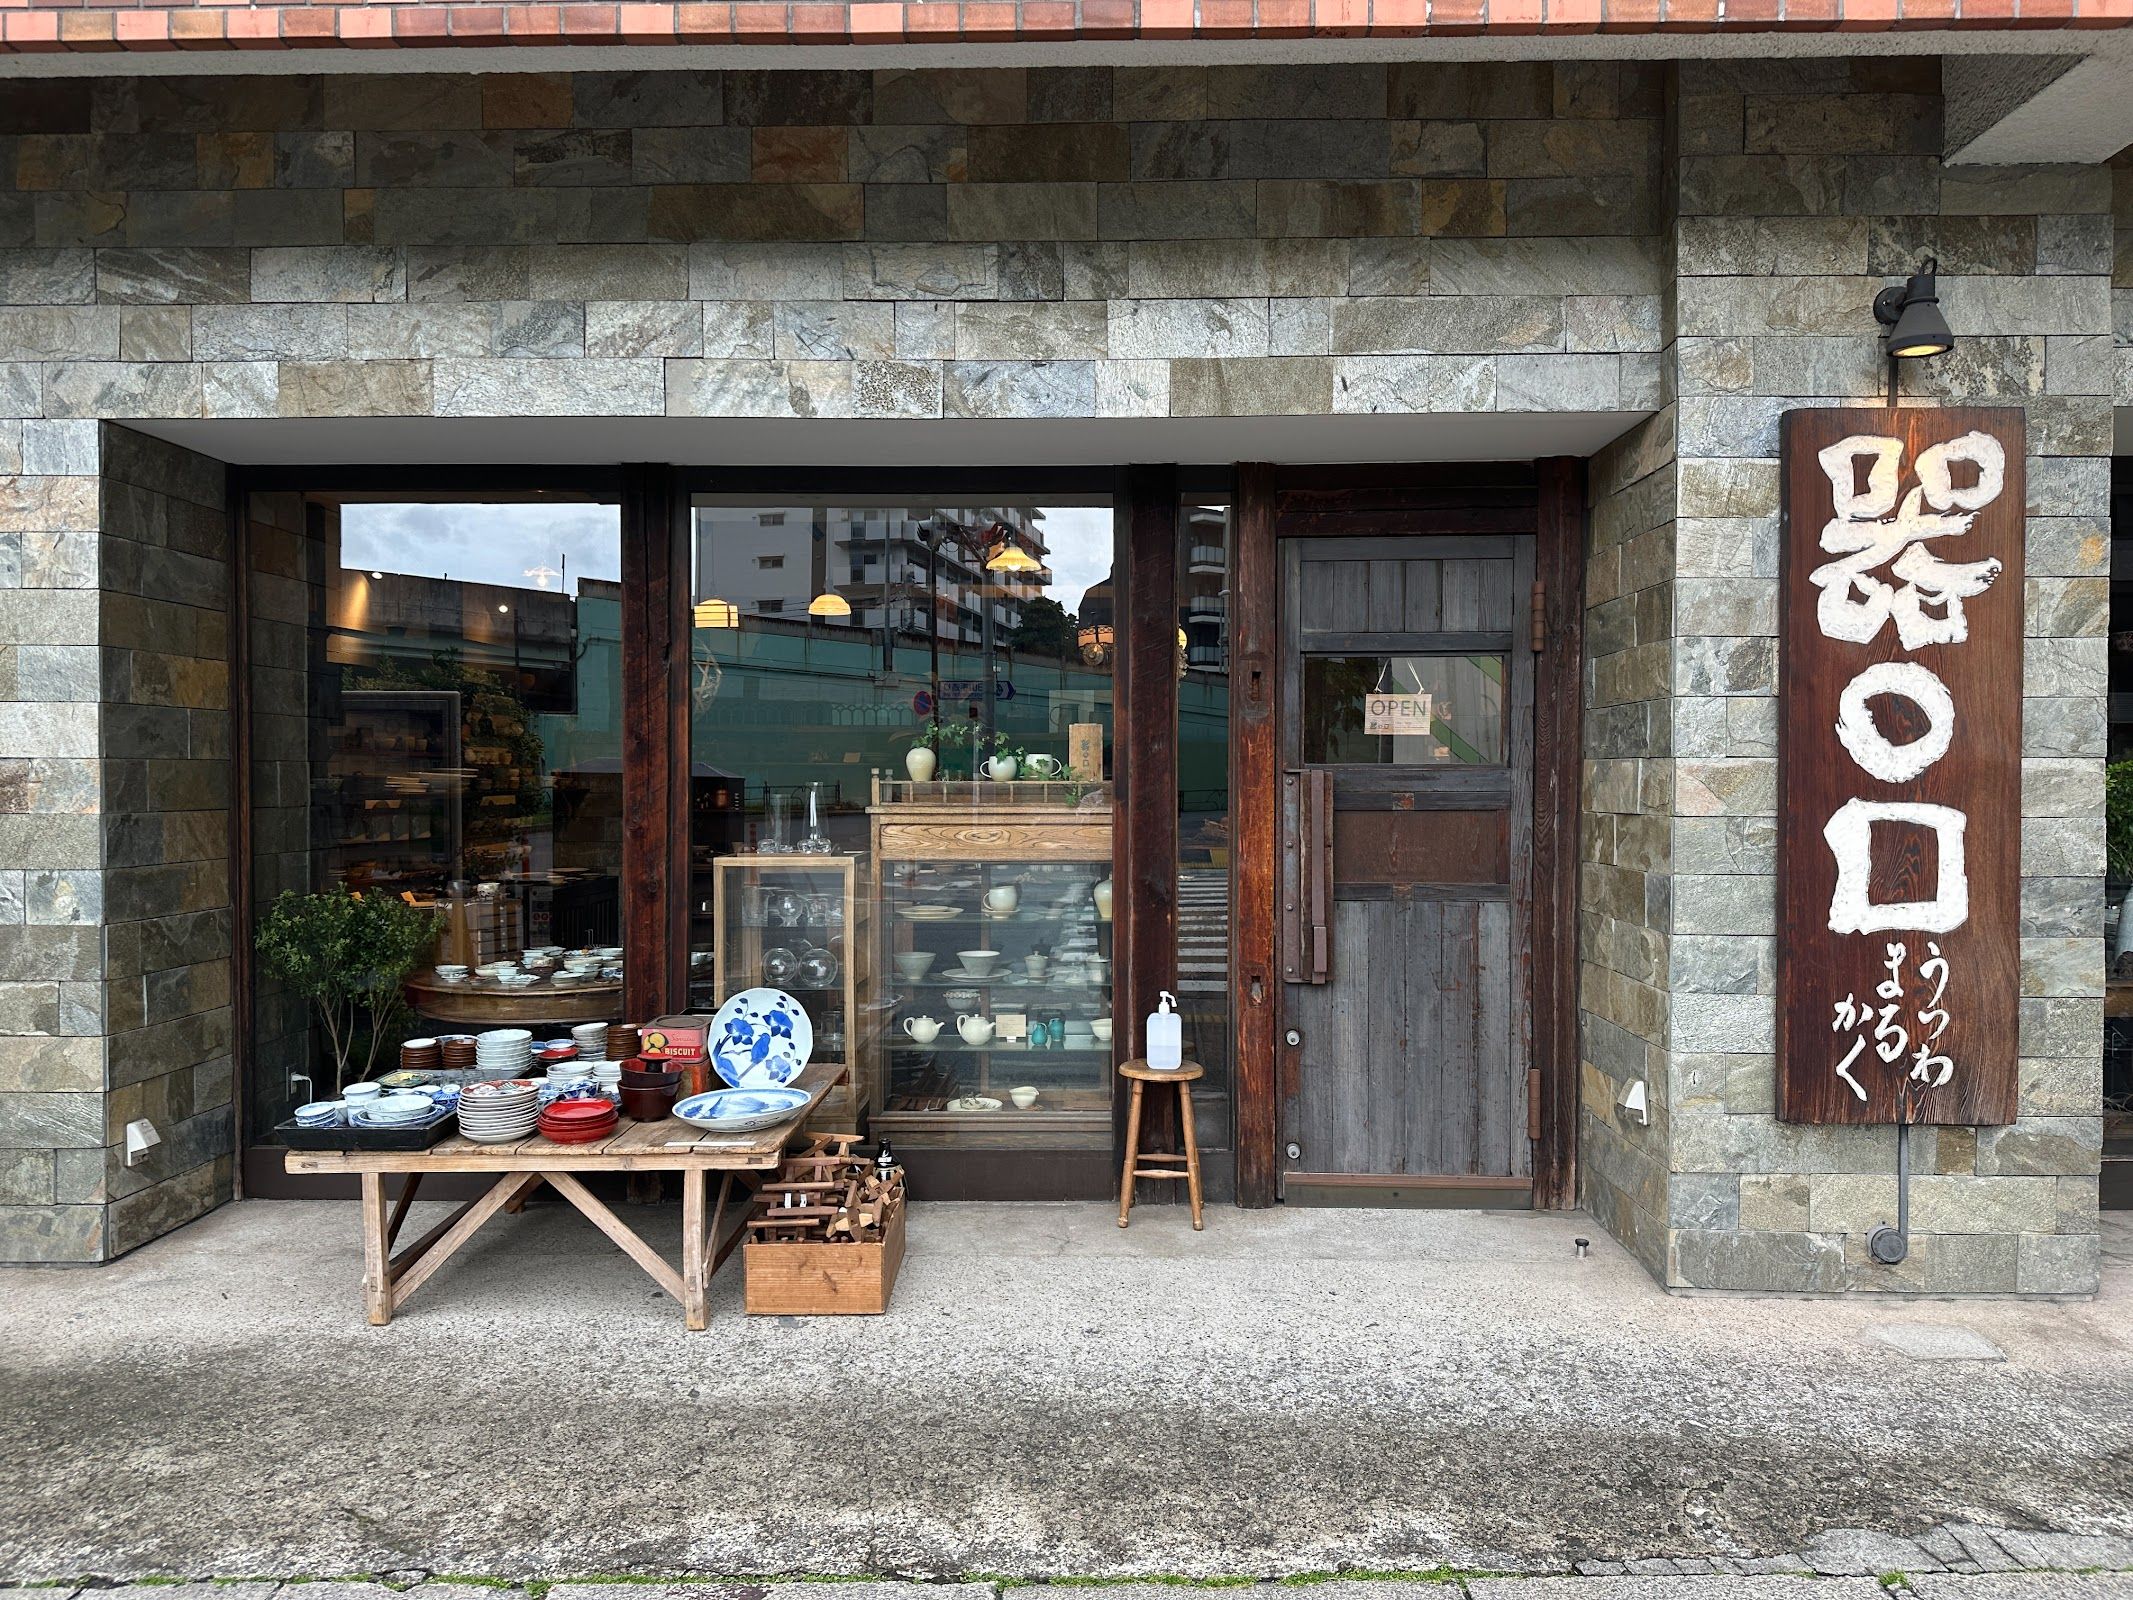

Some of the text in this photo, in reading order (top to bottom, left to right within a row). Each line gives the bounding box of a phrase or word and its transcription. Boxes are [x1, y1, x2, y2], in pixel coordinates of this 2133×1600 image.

[1371, 699, 1426, 717] OPEN
[665, 1047, 696, 1056] BISCUIT
[1831, 992, 1875, 1102] かく
[1873, 941, 1909, 1064] まる
[1910, 941, 1954, 1089] うつわ
